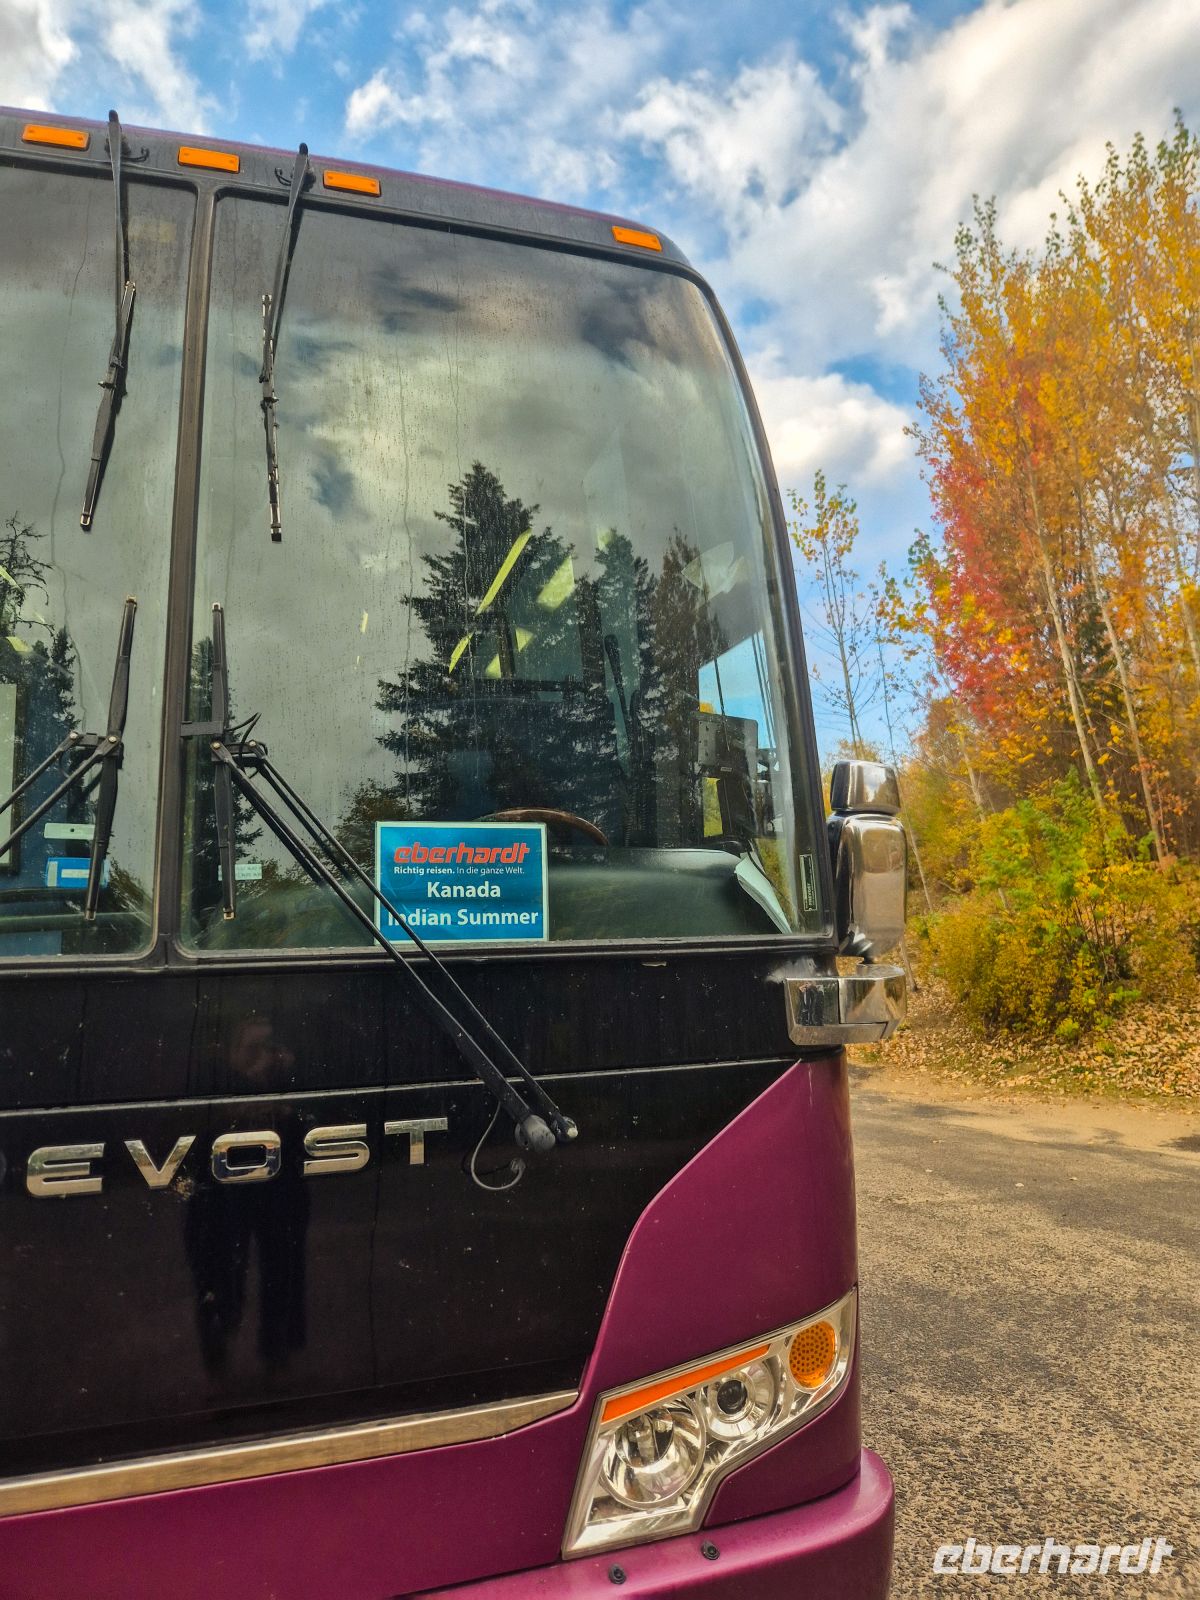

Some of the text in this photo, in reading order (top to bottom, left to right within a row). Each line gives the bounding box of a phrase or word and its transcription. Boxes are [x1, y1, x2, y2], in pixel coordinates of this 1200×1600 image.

[394, 842, 530, 864] eberhardt
[394, 866, 425, 875] Richtig
[426, 866, 455, 875] reisen.
[480, 867, 504, 876] ganze
[505, 866, 525, 874] Welt.
[427, 880, 501, 898] Kanada
[457, 908, 539, 925] Summer
[26, 1117, 448, 1198] EVOST
